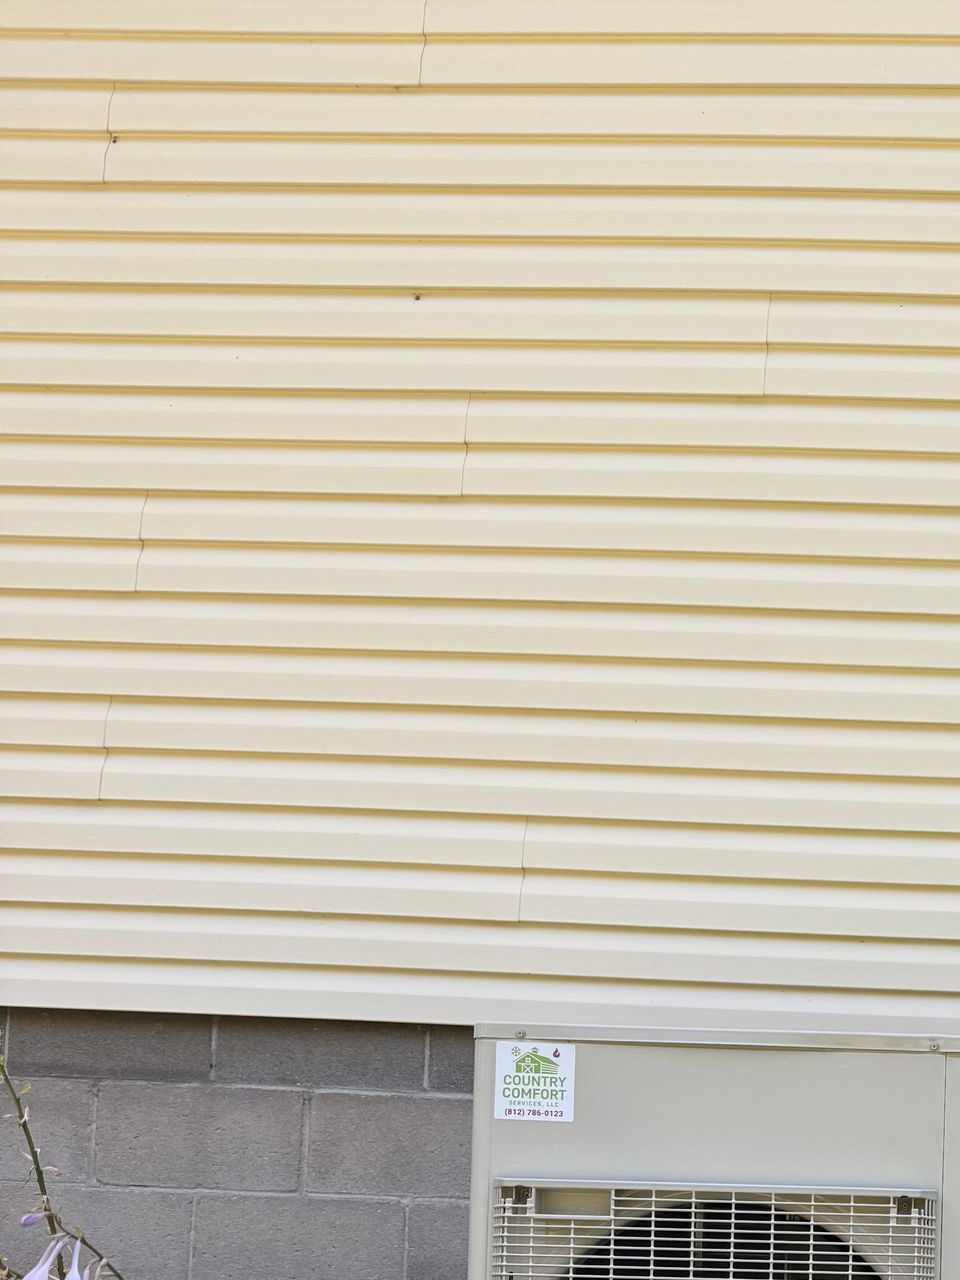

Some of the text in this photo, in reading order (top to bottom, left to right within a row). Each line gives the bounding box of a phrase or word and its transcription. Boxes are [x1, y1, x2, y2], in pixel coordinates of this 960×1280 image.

[504, 1074, 567, 1087] COUNTRY
[502, 1087, 567, 1100] COMFORT
[504, 1108, 564, 1117] (812) 786-0123
